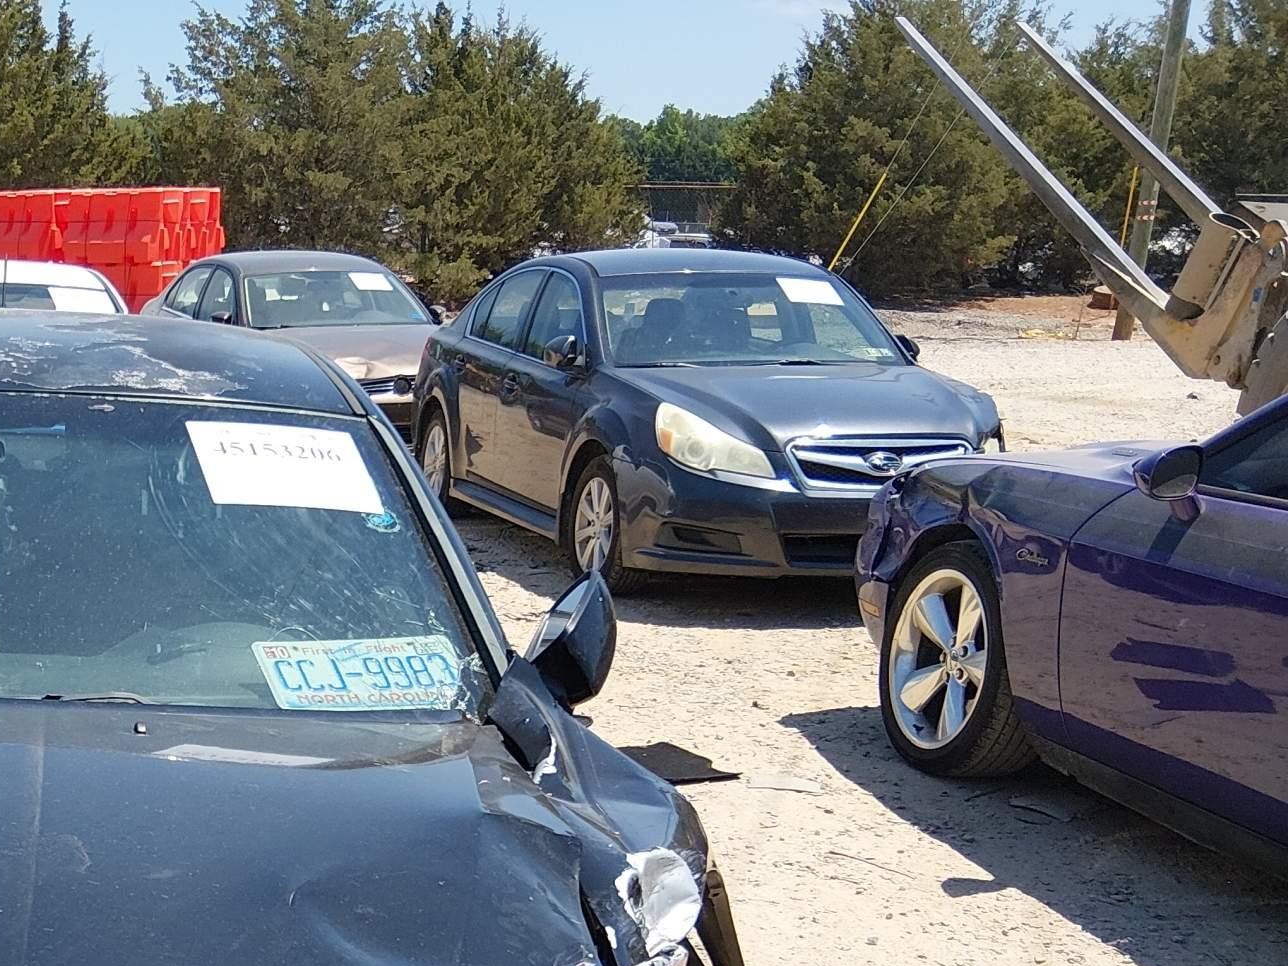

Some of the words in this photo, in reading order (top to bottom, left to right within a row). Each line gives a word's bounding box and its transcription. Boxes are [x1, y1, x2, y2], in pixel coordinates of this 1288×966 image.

[213, 440, 343, 463] 45153206
[302, 647, 334, 656] First
[367, 643, 406, 654] Flight
[274, 655, 459, 692] CCJ-9983
[297, 692, 361, 705] NORTH
